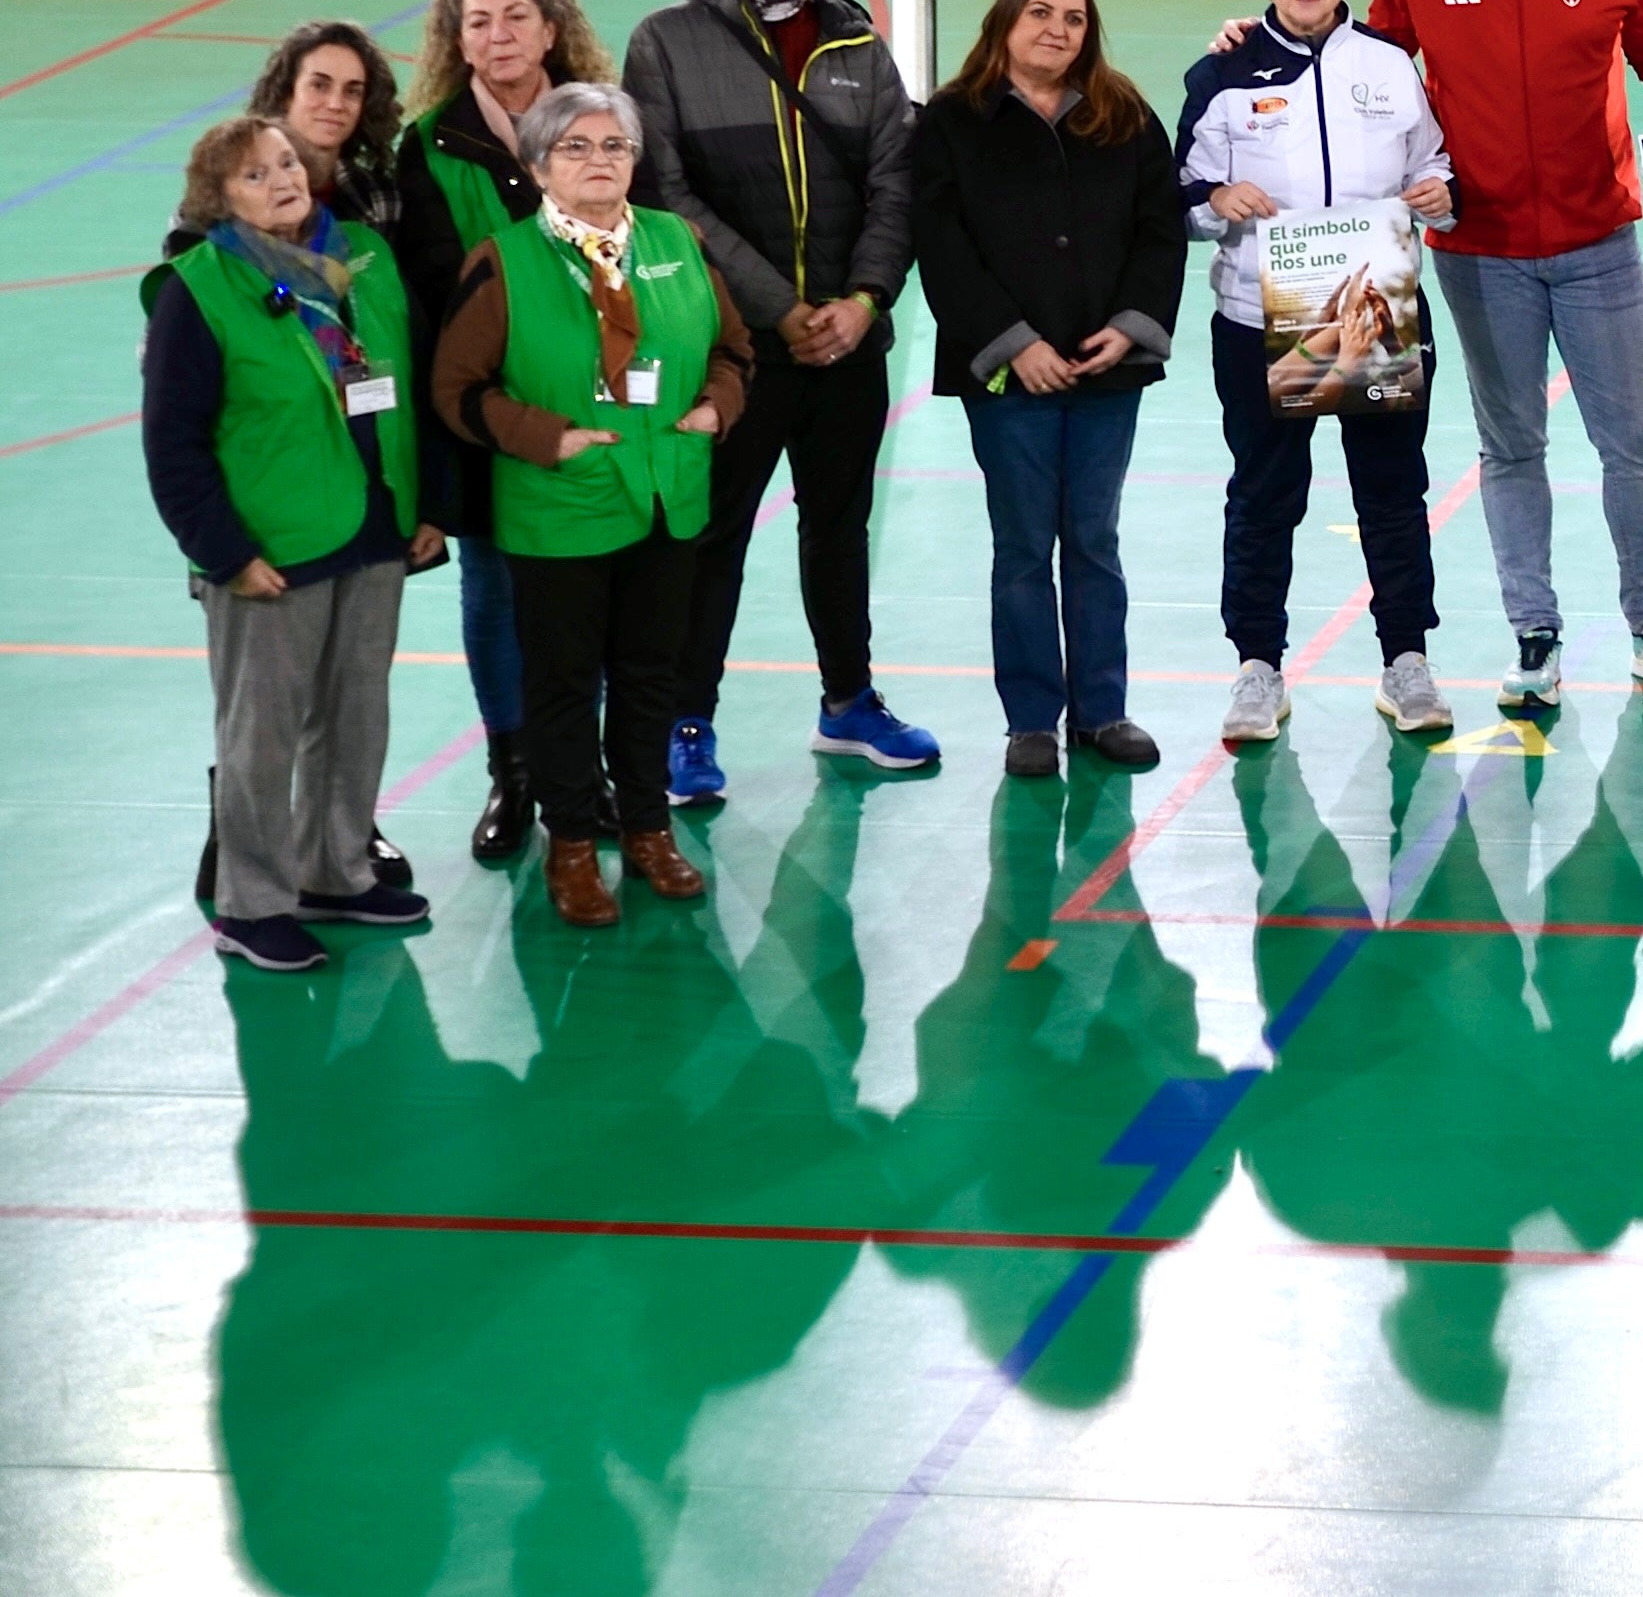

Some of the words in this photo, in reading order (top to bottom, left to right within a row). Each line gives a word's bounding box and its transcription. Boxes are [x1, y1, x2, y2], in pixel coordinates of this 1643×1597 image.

[1269, 226, 1286, 241] El
[1292, 217, 1371, 239] símbolo
[1269, 240, 1308, 259] que
[1270, 255, 1306, 272] nos
[1310, 251, 1348, 268] une
